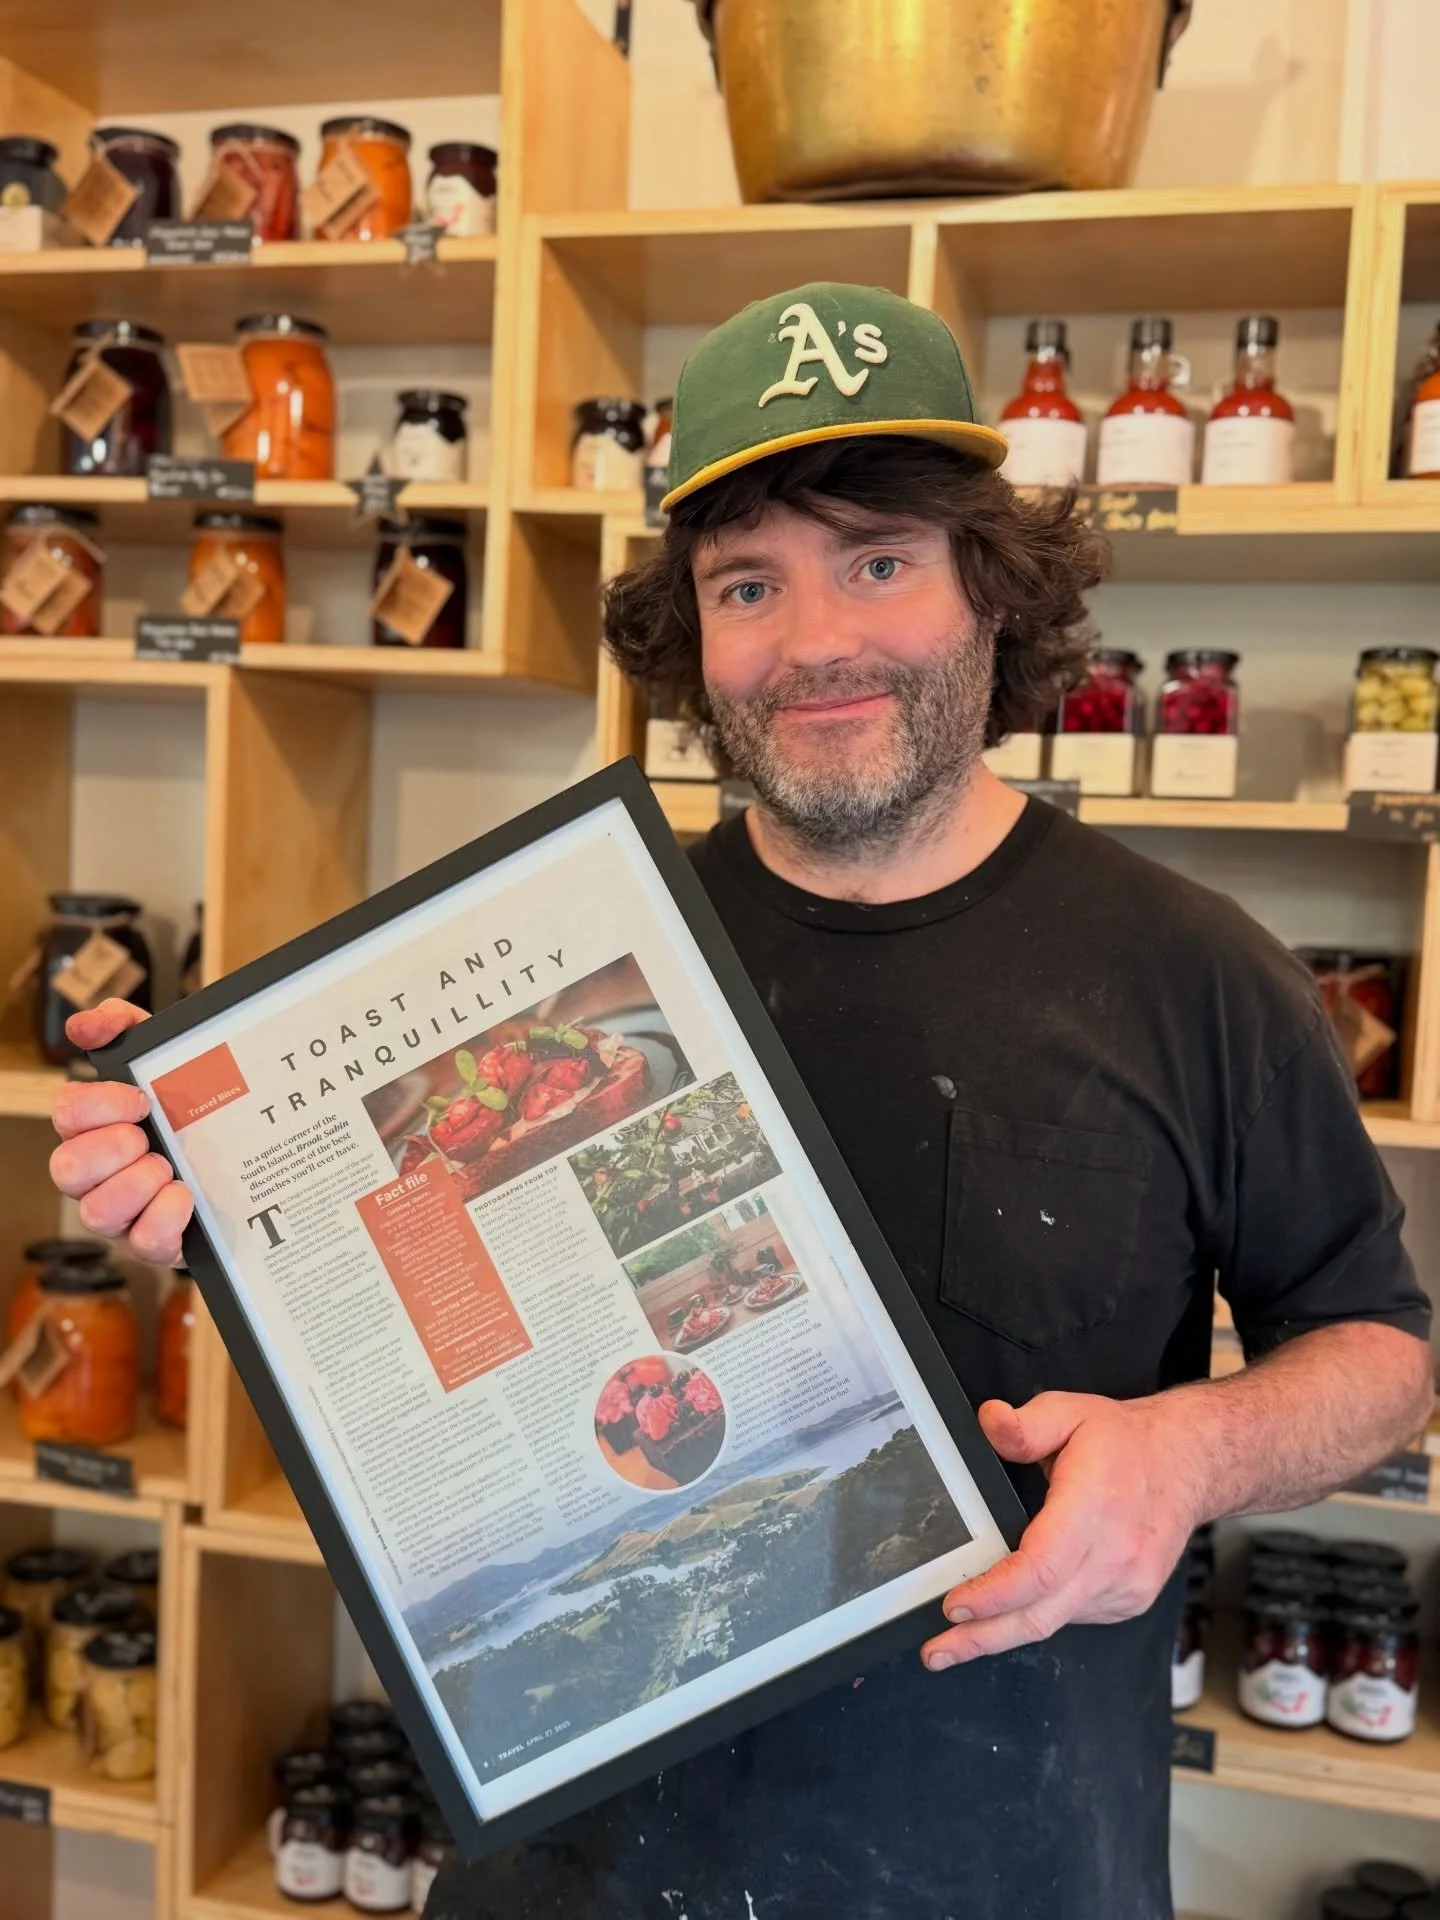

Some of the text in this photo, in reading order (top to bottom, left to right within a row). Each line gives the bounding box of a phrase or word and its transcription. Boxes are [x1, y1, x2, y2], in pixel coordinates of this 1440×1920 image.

[759, 303, 888, 408] A's
[281, 938, 512, 1070] TOAST AND
[261, 950, 562, 1123] TRANQUILLITY
[188, 1087, 240, 1116] Travel Bites
[240, 1120, 349, 1182] South Island, Brook Sabin
[242, 1159, 253, 1168] In
[260, 1143, 283, 1159] quiet
[283, 1127, 311, 1146] corner
[312, 1119, 322, 1131] of
[322, 1114, 336, 1125] the
[249, 1132, 351, 1191] discovers one of the best
[250, 1142, 359, 1202] brunches you'll ever have.
[375, 1173, 427, 1205] Fact file
[474, 1165, 558, 1213] PHOTOGRAPHS FROM TOP
[387, 1190, 431, 1216] Getting there:
[435, 1291, 479, 1318] Staying there:
[455, 1330, 497, 1354] Eating there:
[497, 1744, 524, 1760] TRAVEL
[526, 1734, 544, 1746] APRIL
